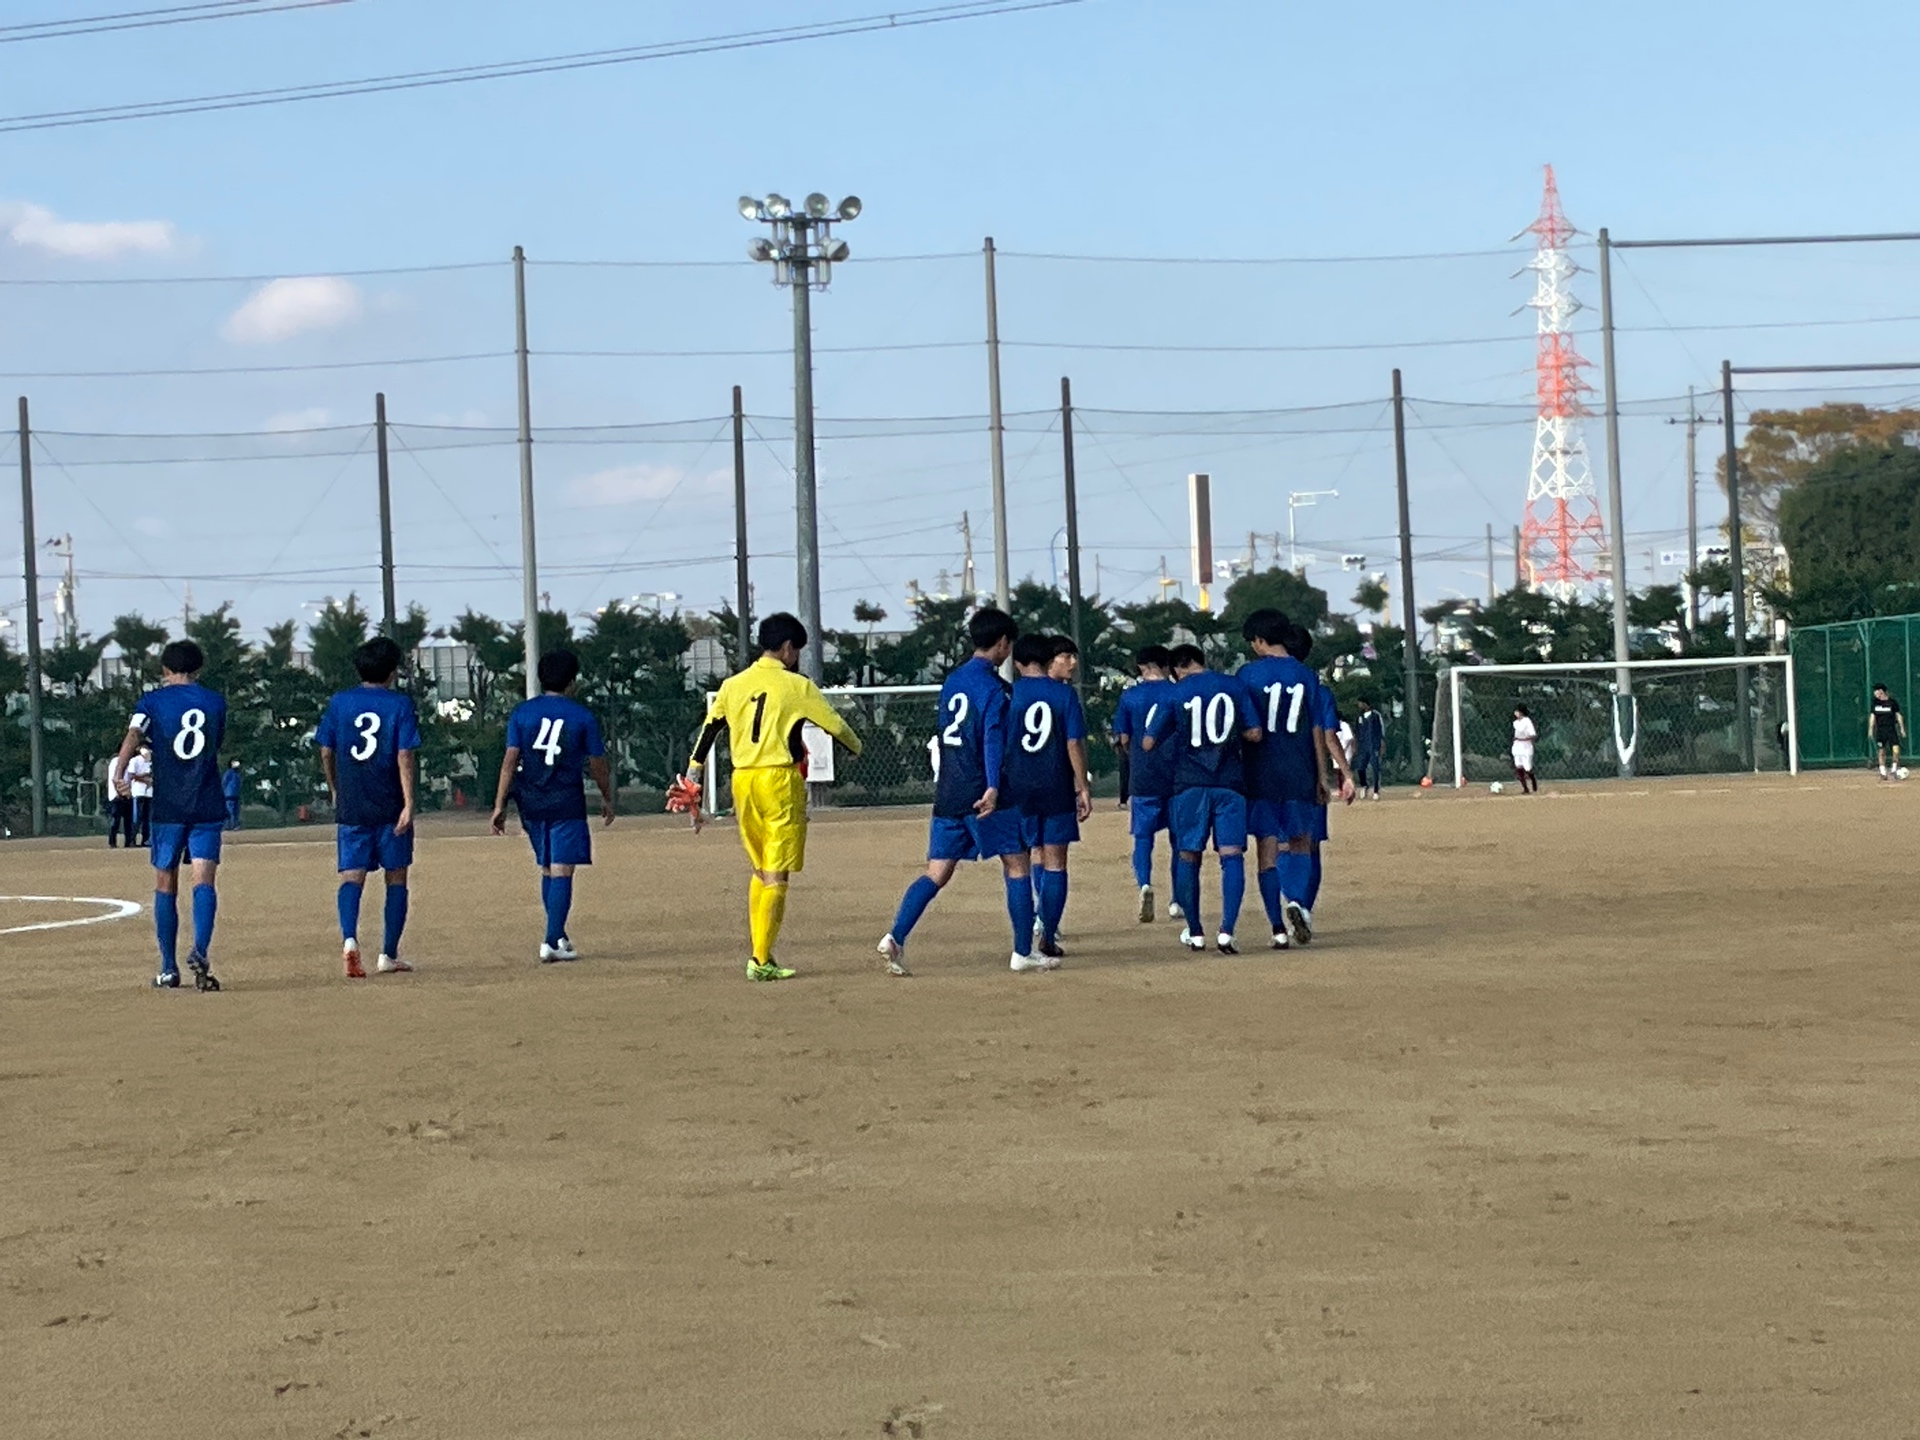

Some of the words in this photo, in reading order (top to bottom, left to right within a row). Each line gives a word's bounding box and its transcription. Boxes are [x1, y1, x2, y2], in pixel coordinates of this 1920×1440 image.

[751, 692, 767, 743] 1
[942, 692, 969, 746] 2
[1021, 701, 1052, 752] 9
[1184, 692, 1235, 747] 10
[1263, 682, 1304, 733] 11
[173, 708, 205, 760] 8
[350, 712, 381, 761] 3
[532, 718, 563, 765] 4
